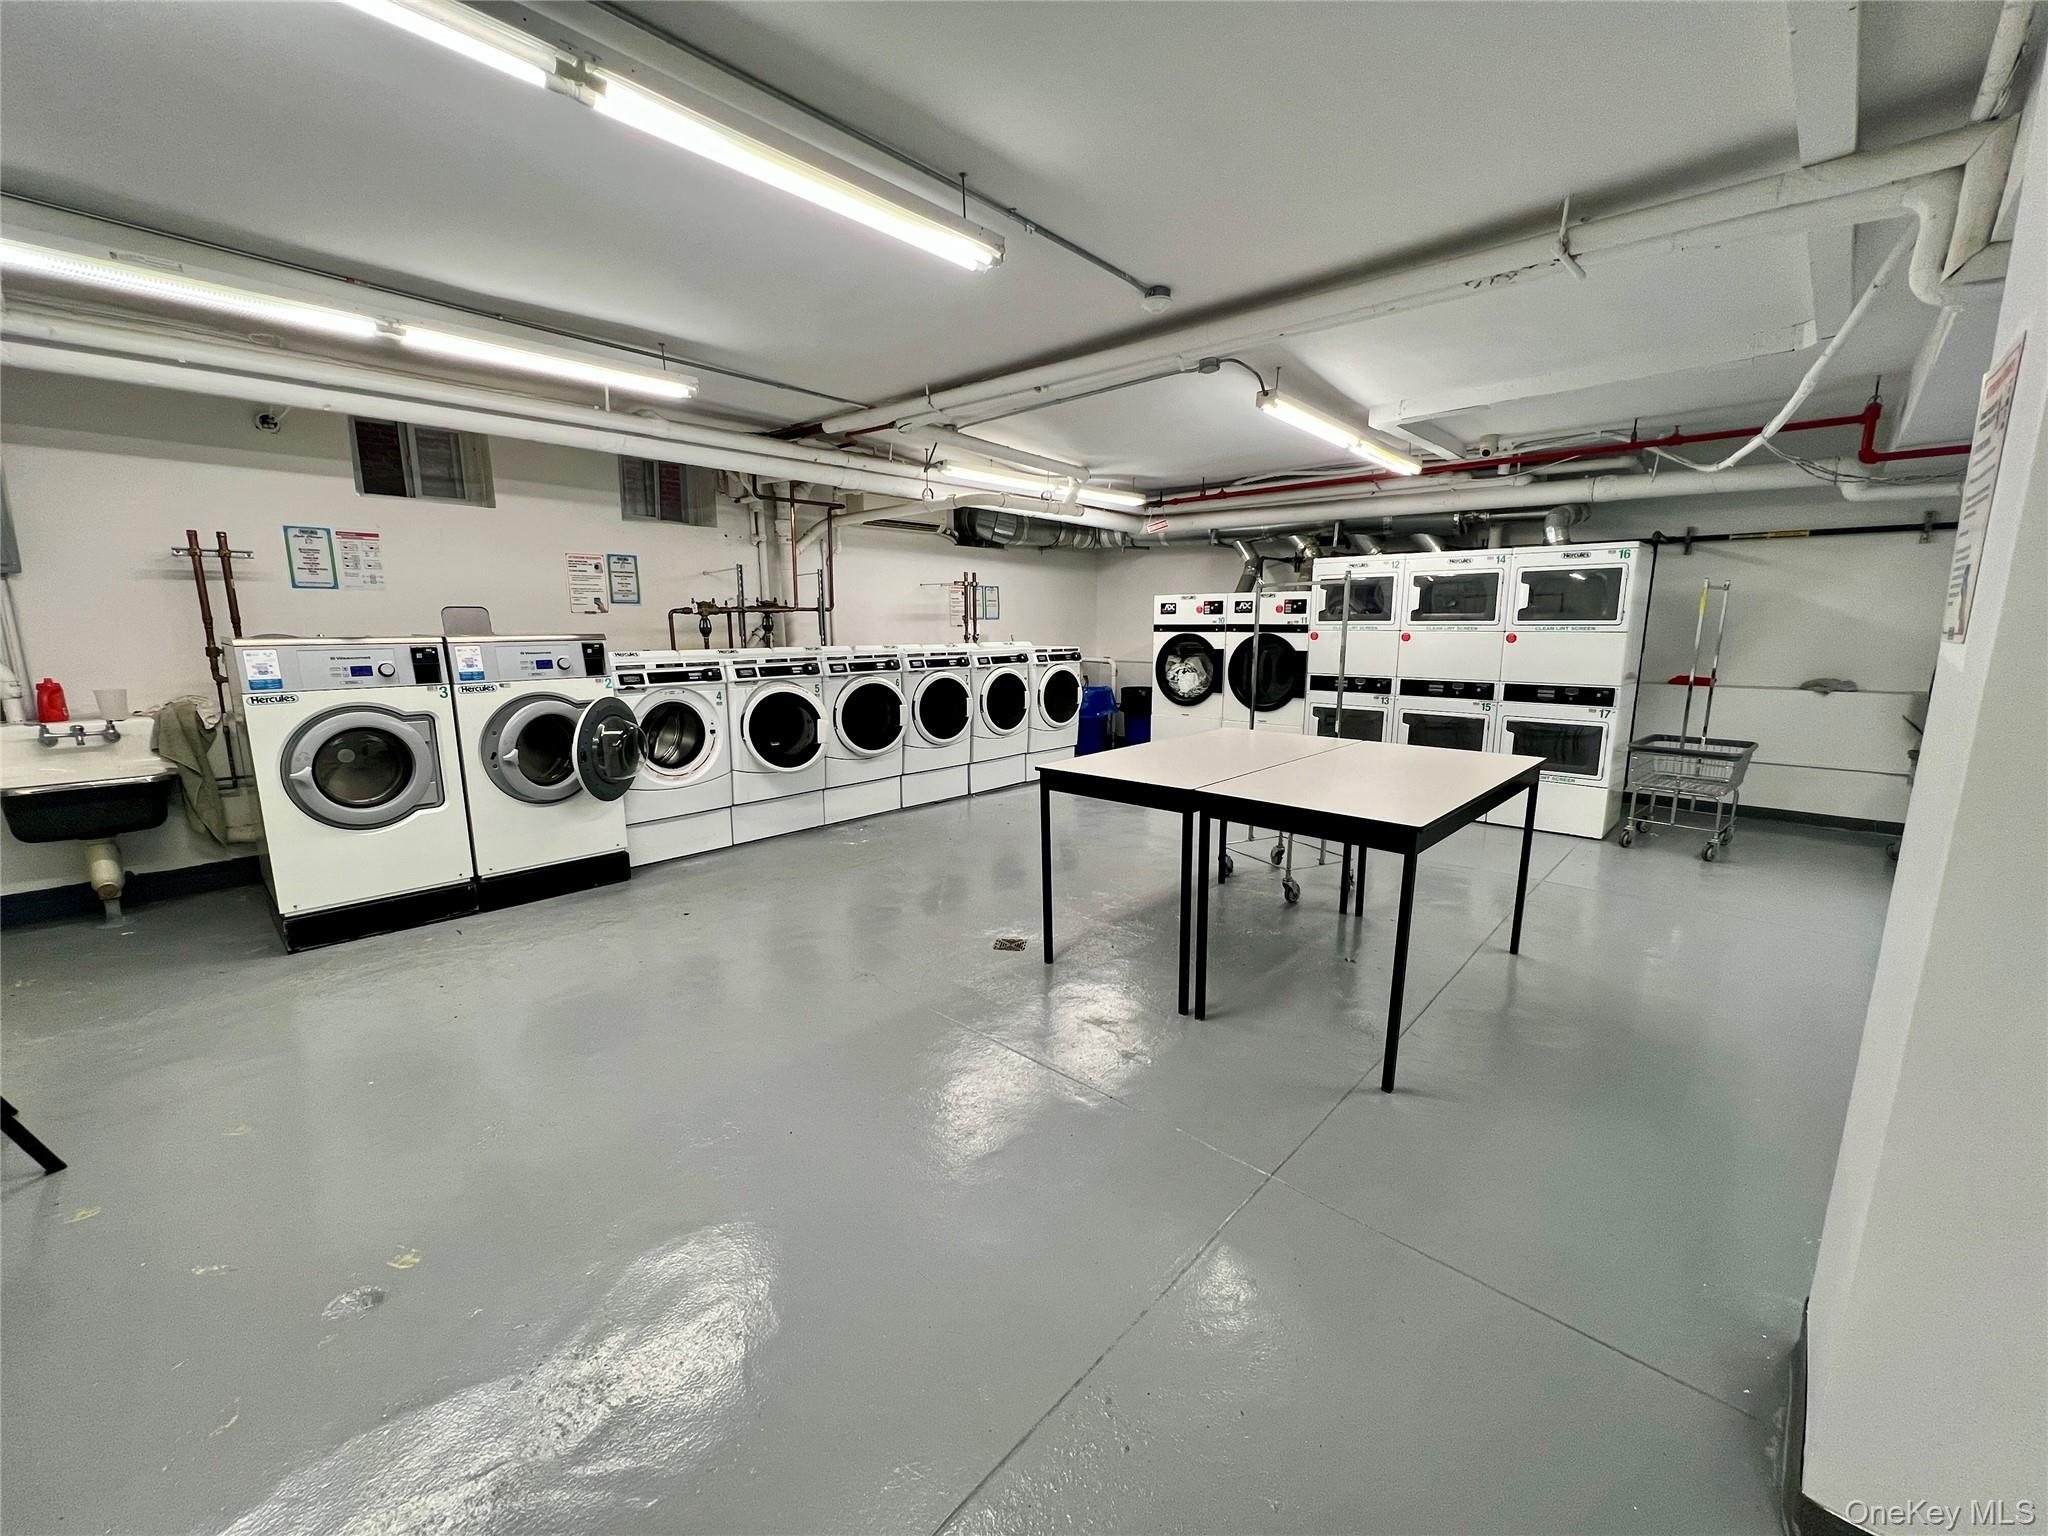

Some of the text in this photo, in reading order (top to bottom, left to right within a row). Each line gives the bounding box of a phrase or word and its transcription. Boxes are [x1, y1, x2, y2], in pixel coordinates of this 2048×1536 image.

[1619, 549, 1631, 559] 16
[1496, 555, 1506, 564] 14
[1392, 560, 1400, 569] 12
[1218, 616, 1225, 624] 10
[604, 678, 612, 689] 2
[439, 687, 449, 698] 3
[461, 684, 496, 693] Hercules
[814, 684, 820, 693] 5
[250, 694, 296, 706] Hercules
[715, 691, 722, 700] 4
[1381, 696, 1389, 705] 13
[1481, 702, 1491, 712] 15
[1599, 709, 1611, 719] 17
